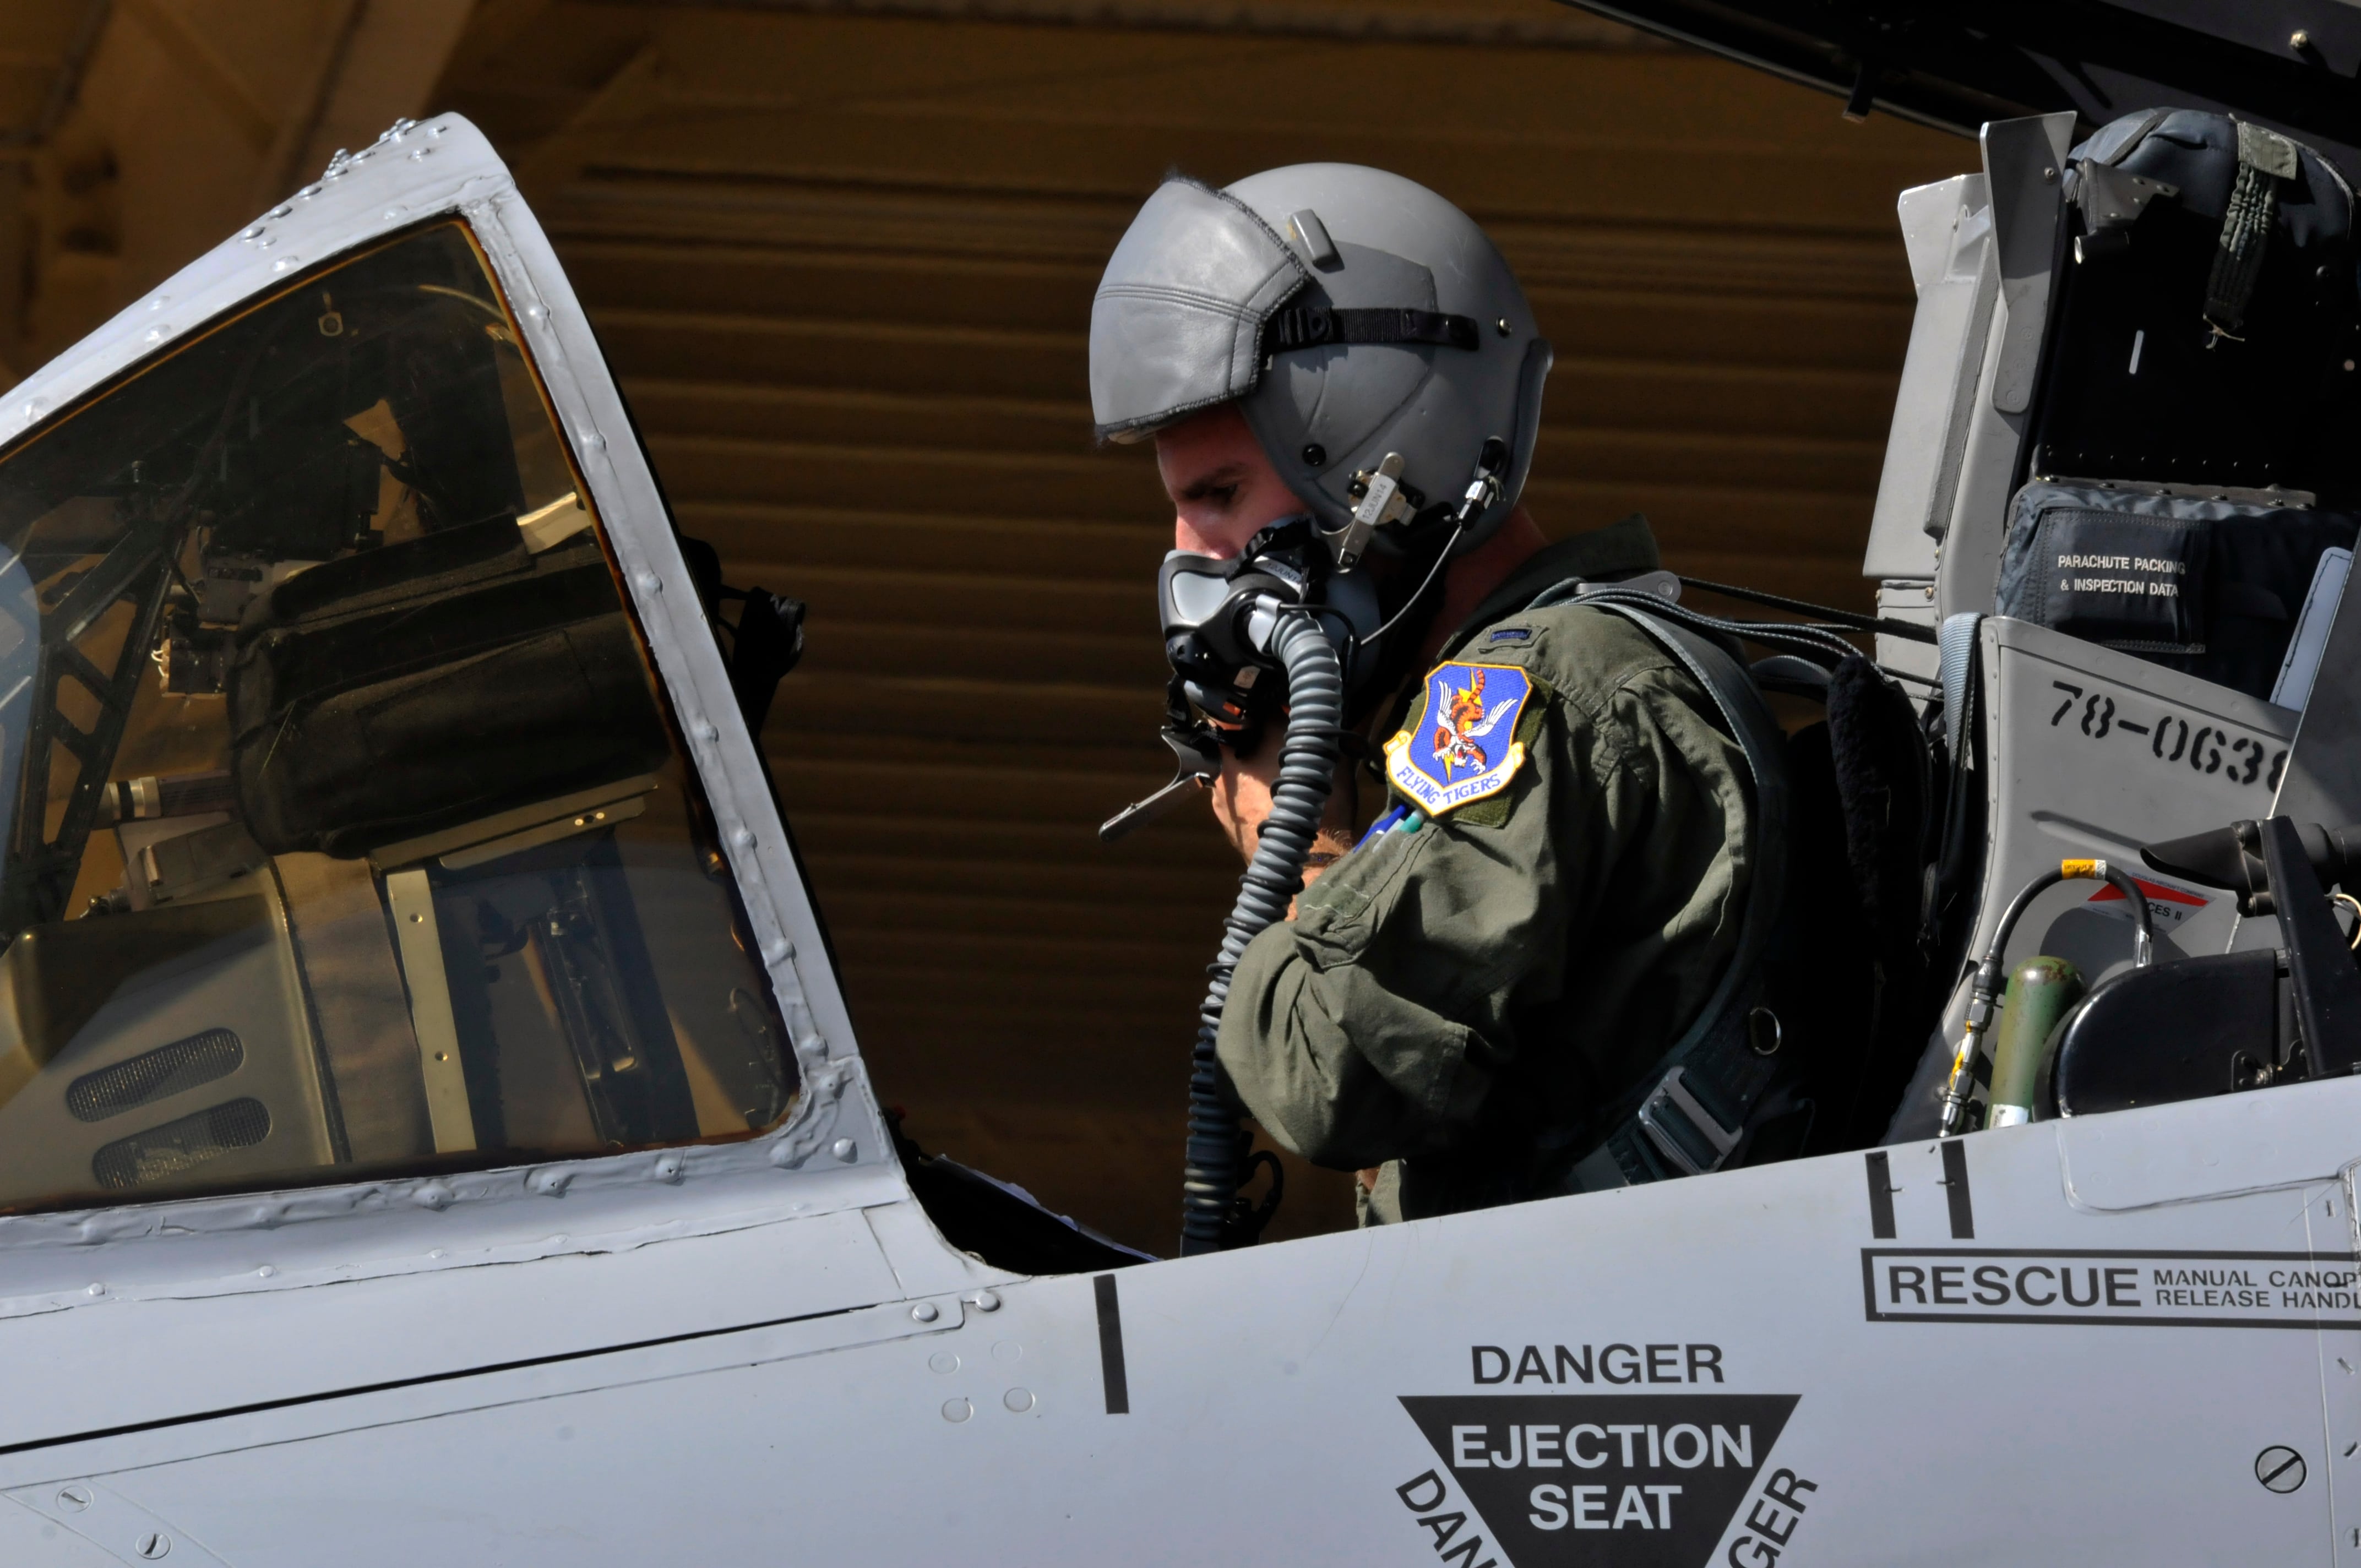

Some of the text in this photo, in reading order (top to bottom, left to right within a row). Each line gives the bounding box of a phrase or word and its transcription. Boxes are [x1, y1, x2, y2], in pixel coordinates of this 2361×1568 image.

[2058, 555, 2186, 575] PARACHUTE PACKING
[2060, 579, 2179, 597] & INSPECTION DATA
[1396, 766, 1501, 804] FLYING TIGERS
[2148, 902, 2171, 917] CES
[1889, 1265, 2141, 1307] RESCUE
[2153, 1270, 2257, 1287] MANUAL
[2156, 1289, 2271, 1308] RELEASE
[1471, 1343, 1724, 1385] DANGER
[1451, 1423, 1753, 1469] EJECTION
[1528, 1483, 1683, 1530] SEAT
